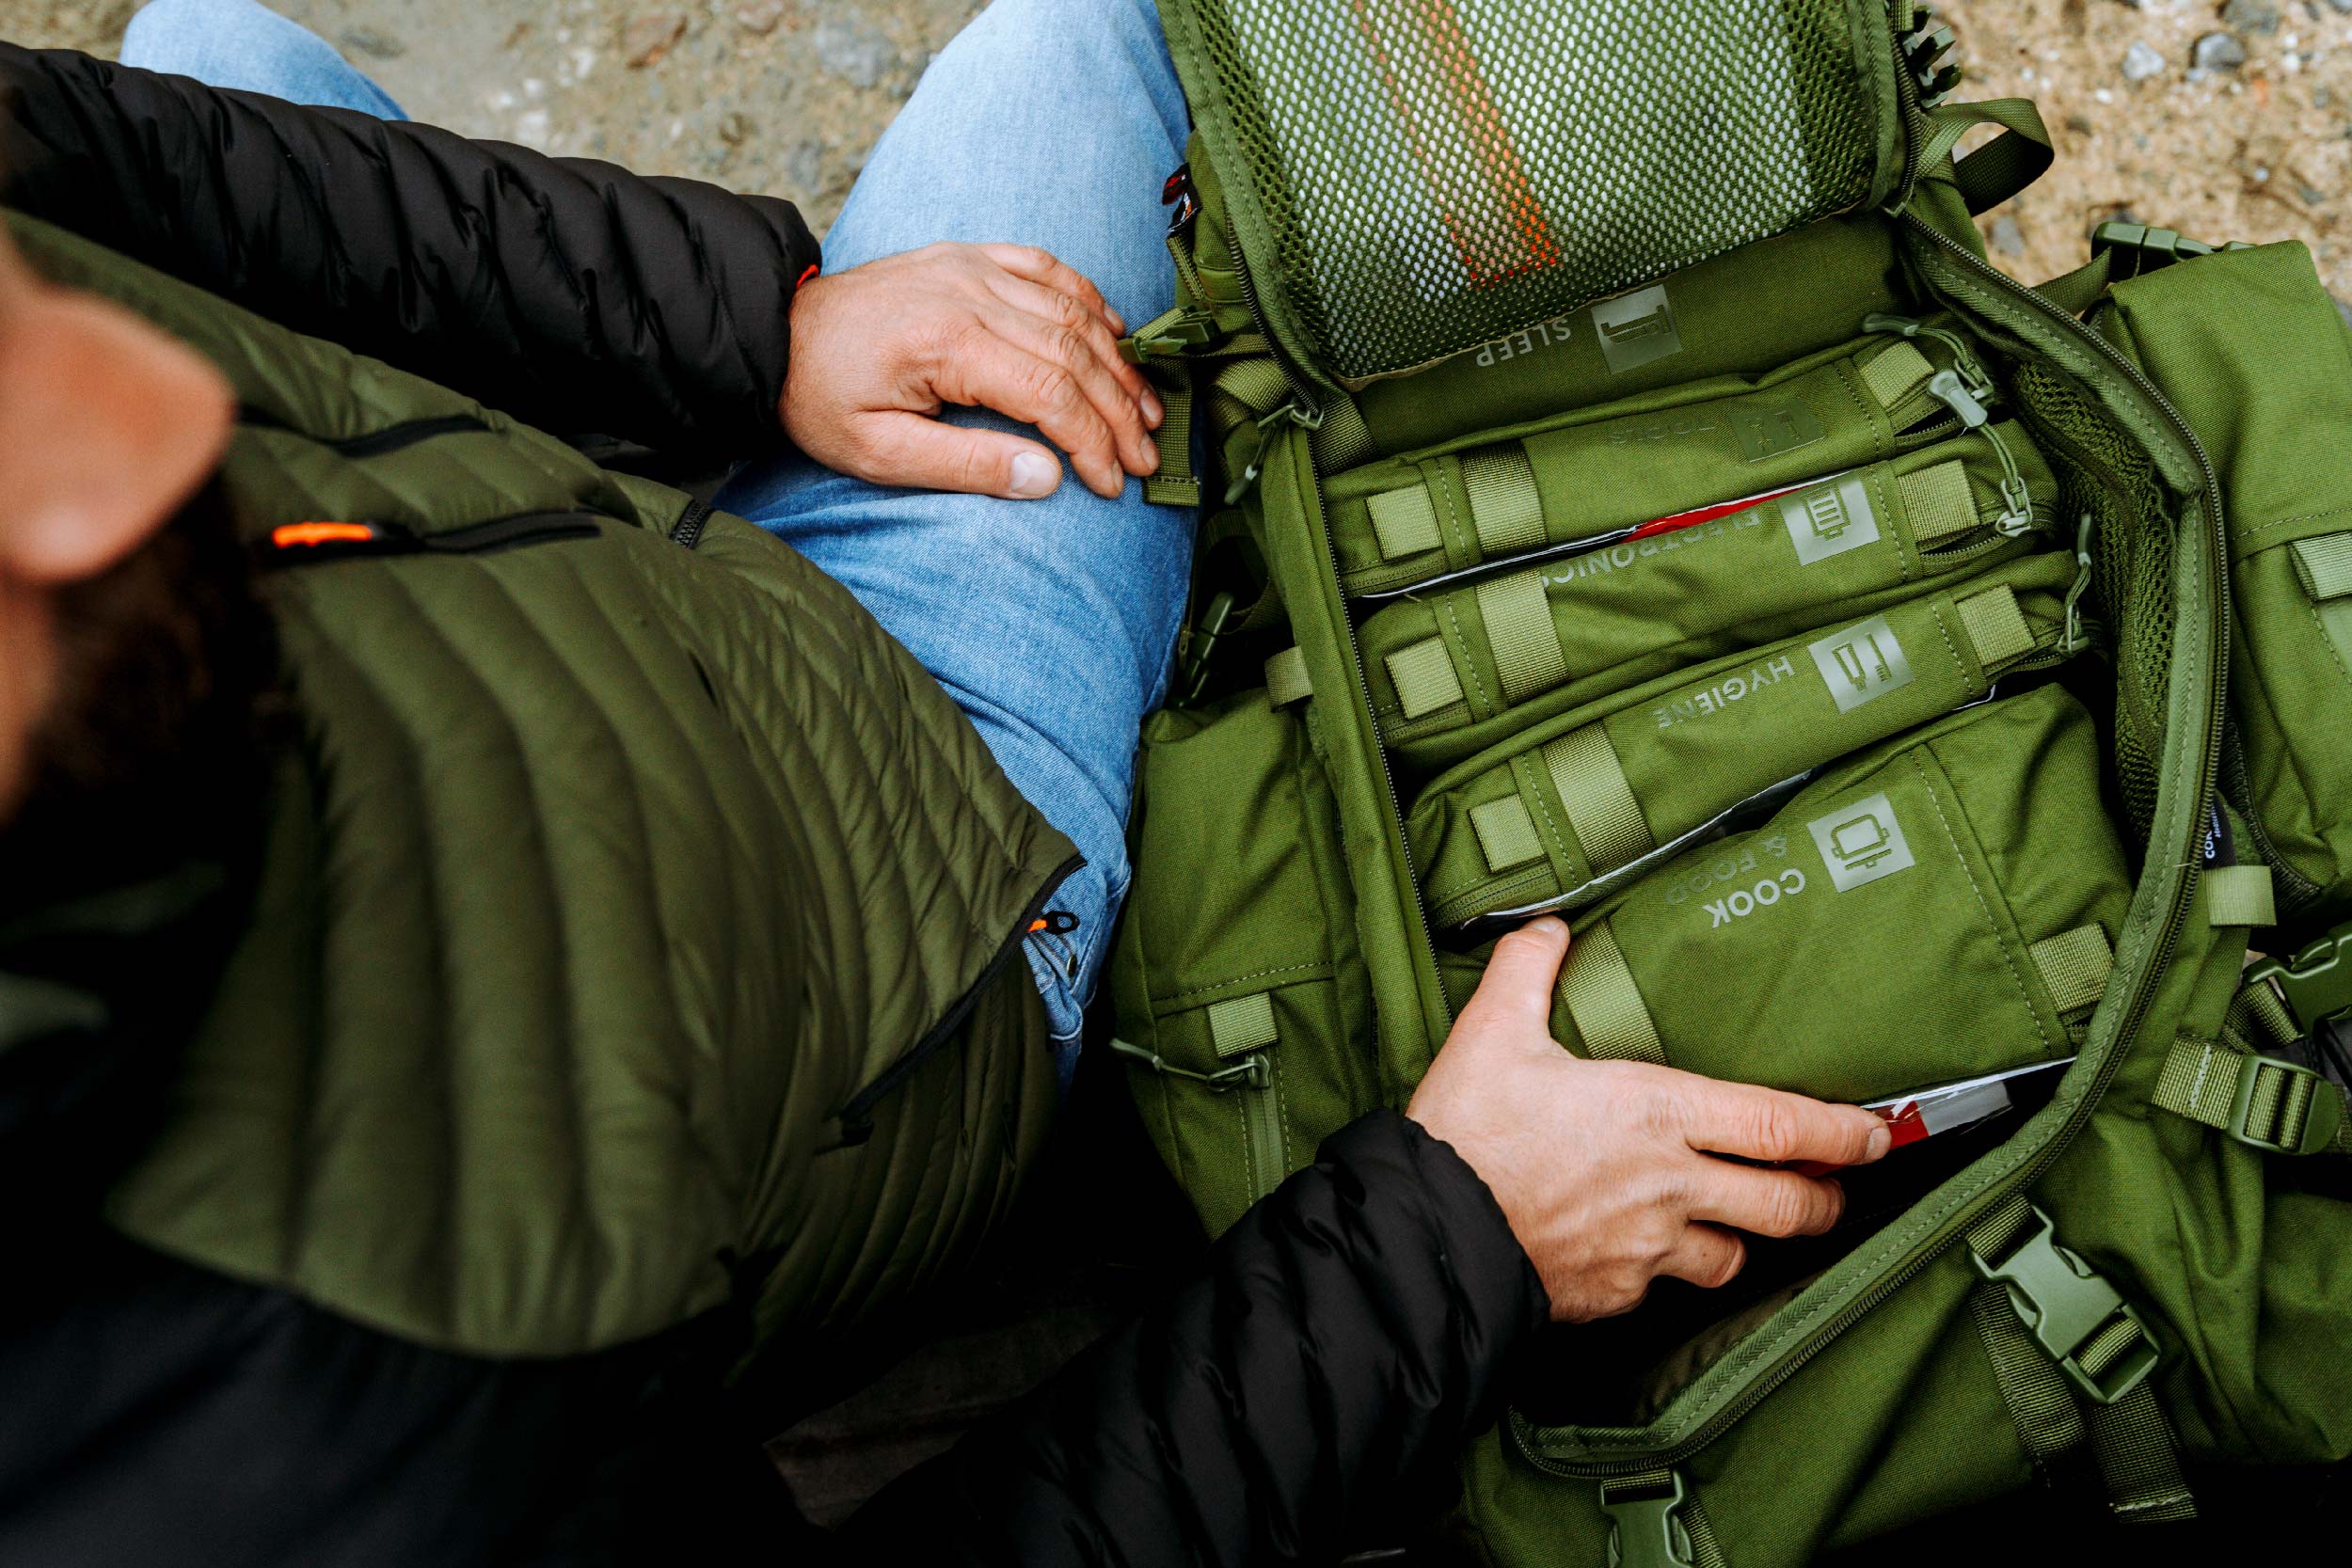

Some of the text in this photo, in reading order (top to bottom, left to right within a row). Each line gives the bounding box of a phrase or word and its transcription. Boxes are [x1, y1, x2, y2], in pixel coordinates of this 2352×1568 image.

[1476, 318, 1571, 367] SLEEP
[1609, 416, 1716, 444] TOOLS
[1653, 656, 1795, 729] HYGIENE
[1665, 835, 1788, 905] & FOOD
[1702, 868, 1805, 928] COOK
